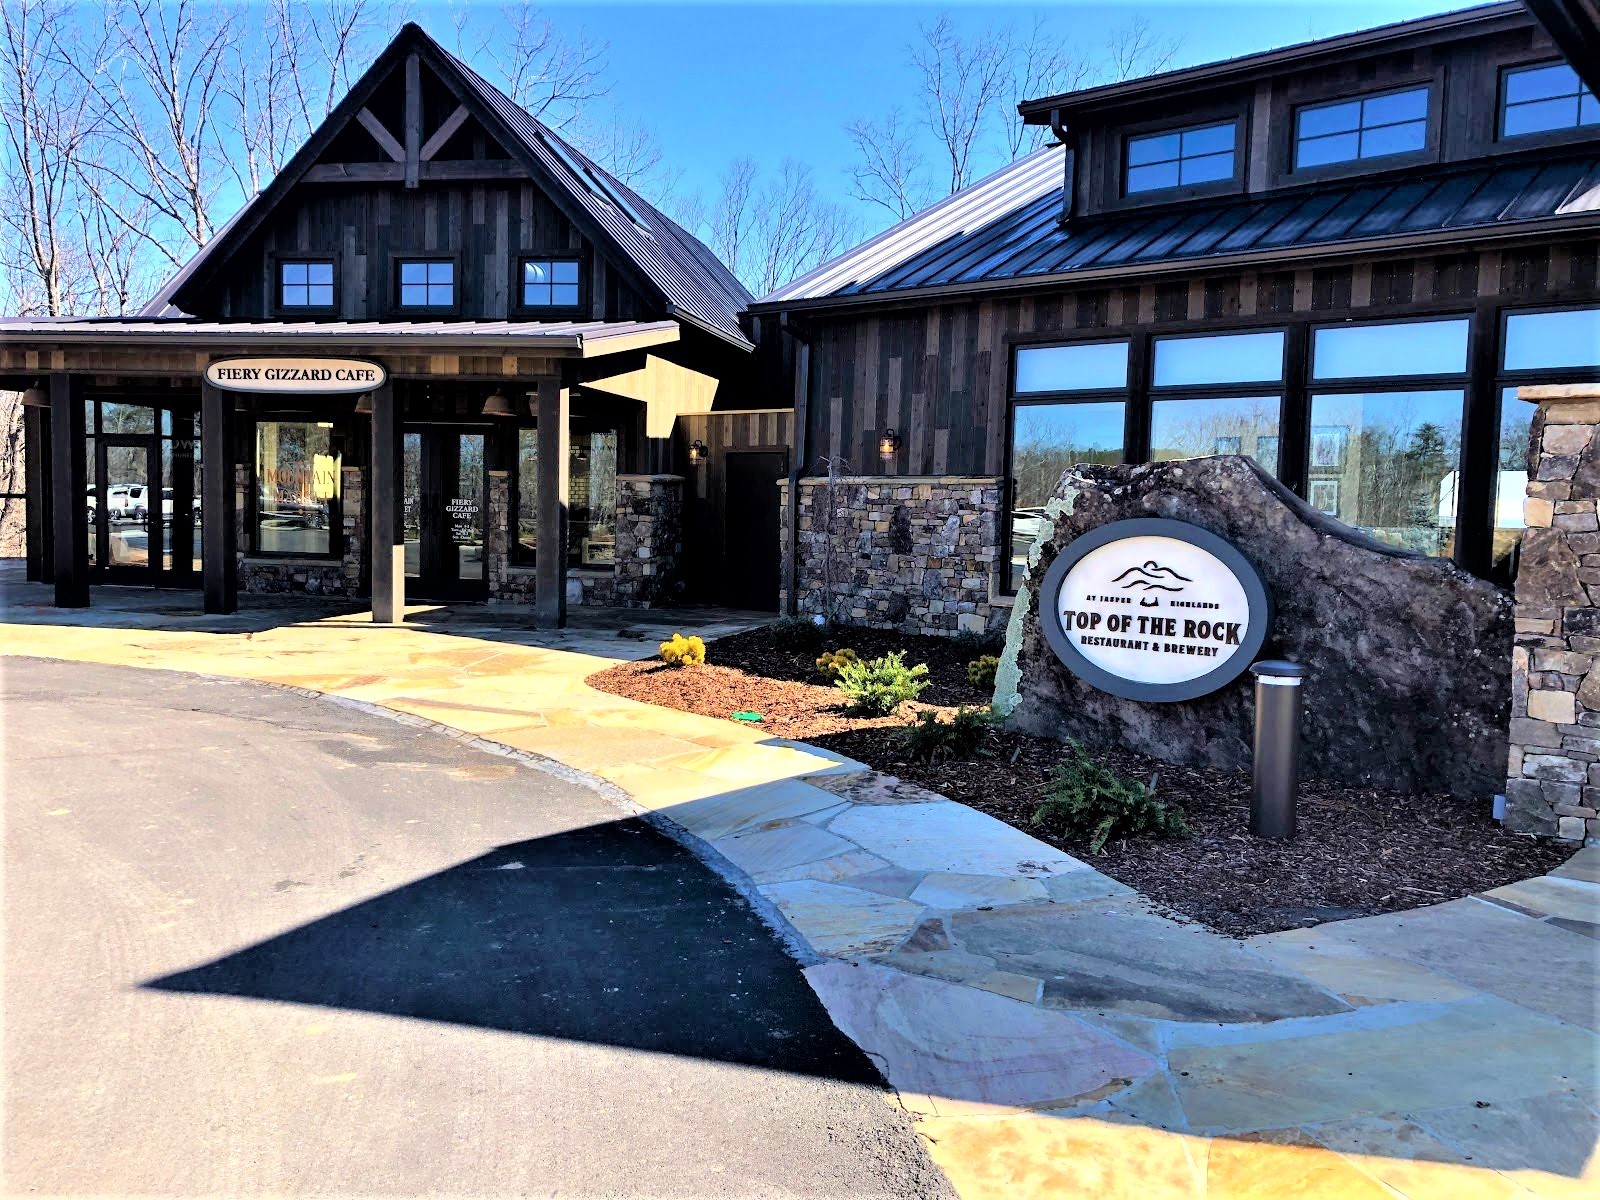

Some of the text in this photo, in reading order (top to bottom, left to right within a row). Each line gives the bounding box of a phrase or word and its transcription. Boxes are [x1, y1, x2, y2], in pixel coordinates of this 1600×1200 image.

[217, 368, 375, 381] FIERY GIZZARD CAFE
[1170, 601, 1219, 609] HIGHLANDS
[1064, 611, 1242, 645] TOP OF THE ROCK
[1081, 636, 1219, 656] RESTAURANT & BREWERY
